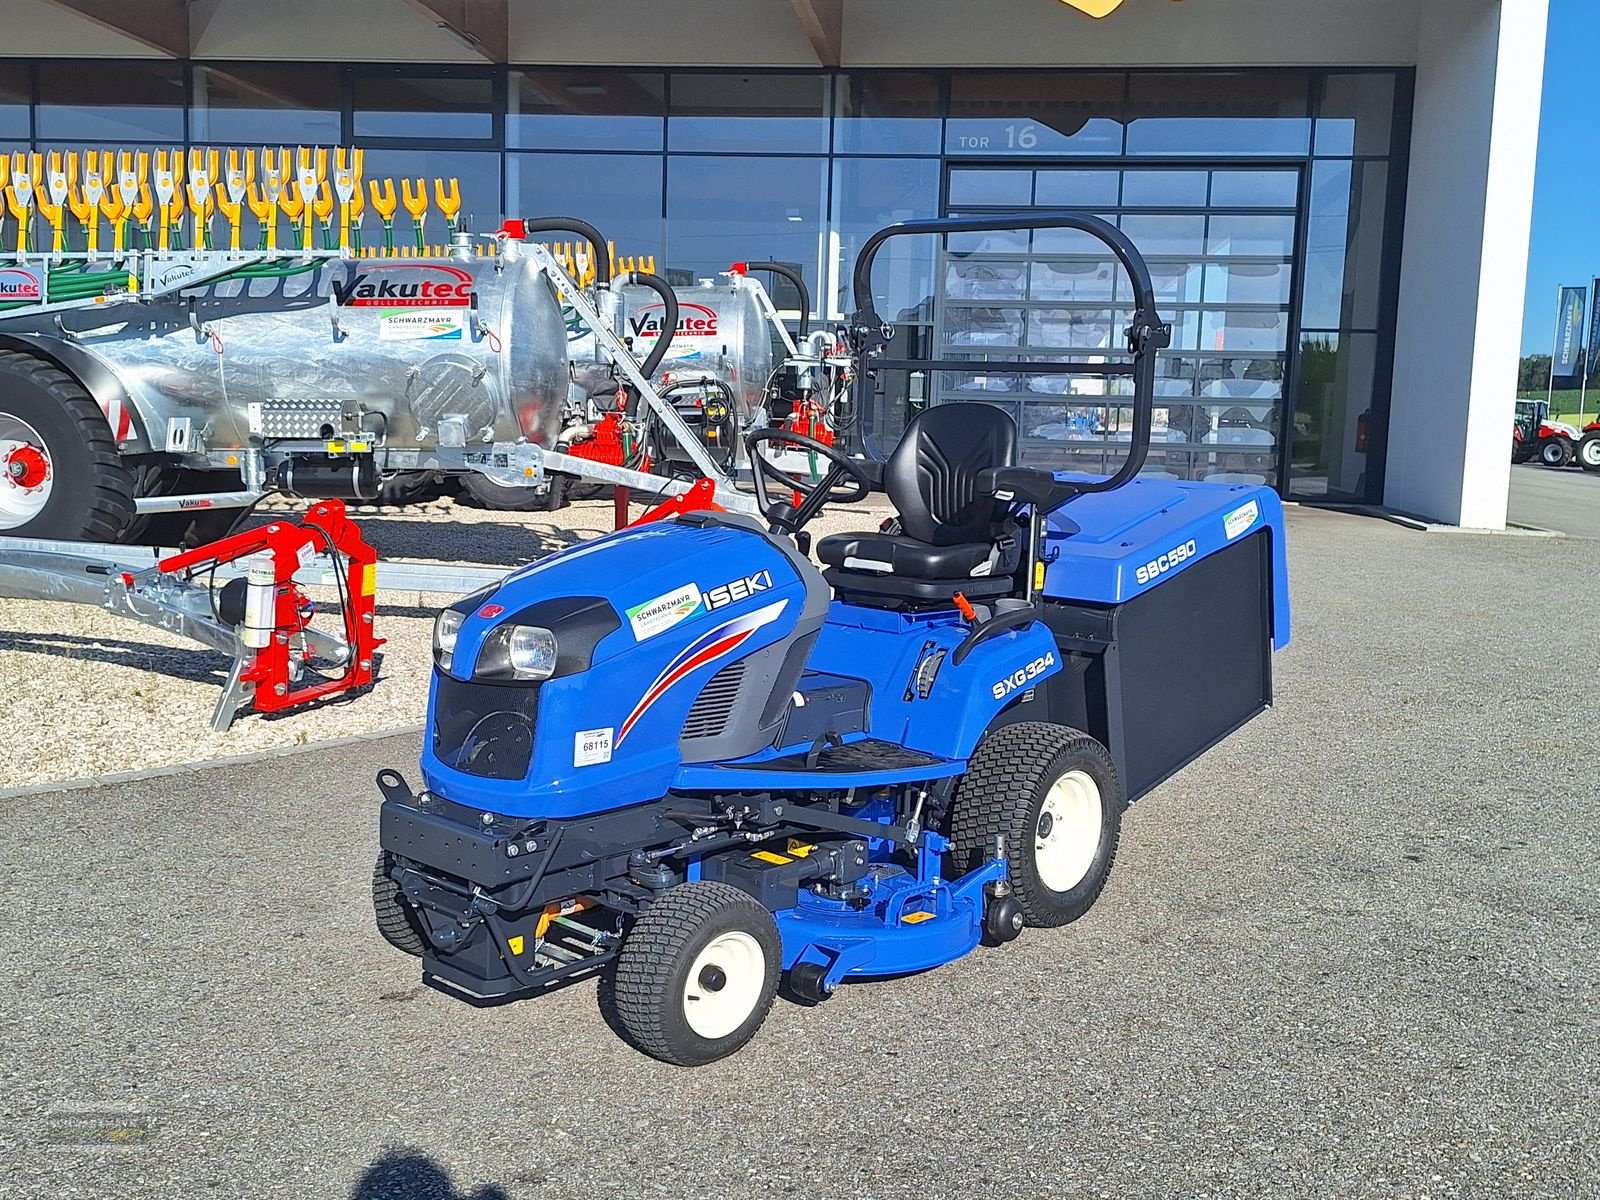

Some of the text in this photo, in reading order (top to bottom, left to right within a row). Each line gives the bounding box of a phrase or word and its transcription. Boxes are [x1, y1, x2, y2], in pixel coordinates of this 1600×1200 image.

[959, 125, 1037, 149] TOR 16
[160, 269, 195, 287] Vakutec
[332, 274, 473, 307] Vakutec
[1136, 538, 1197, 585] SBC590
[702, 569, 773, 612] ISEKI
[636, 594, 691, 622] SCHWARZMAYR
[583, 739, 609, 752] 68115
